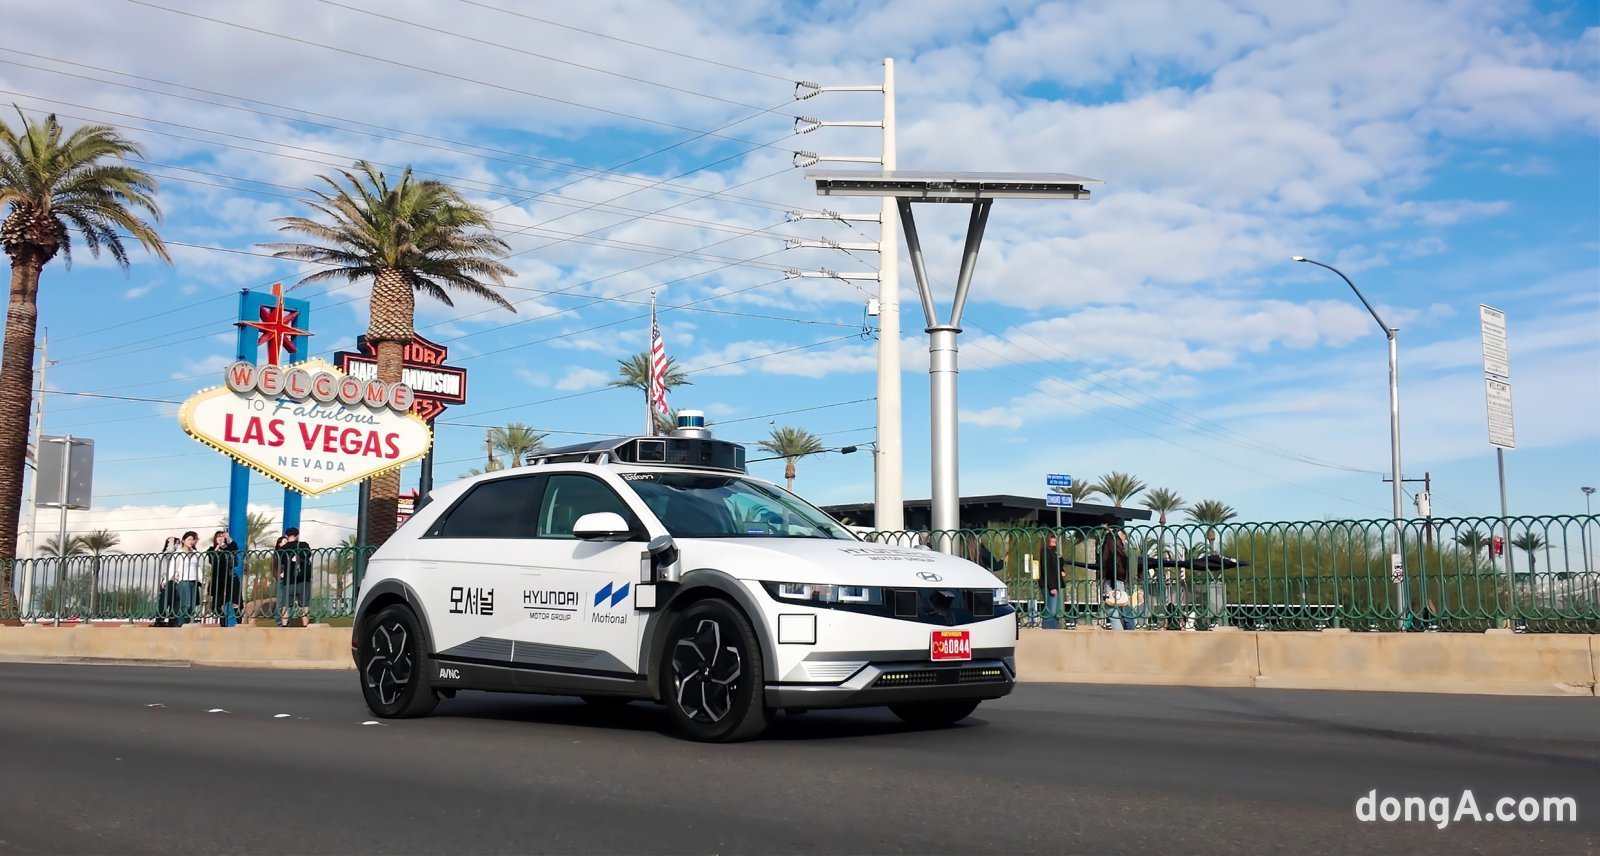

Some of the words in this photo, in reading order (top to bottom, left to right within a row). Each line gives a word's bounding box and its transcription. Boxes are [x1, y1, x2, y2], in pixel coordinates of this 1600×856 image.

[233, 366, 406, 405] WELCOME
[246, 398, 265, 412] TO
[272, 397, 380, 425] Fabulous
[224, 413, 285, 447] LAS
[298, 421, 401, 460] VEGAS
[278, 455, 346, 473] NEVADA
[449, 586, 494, 616] 모셔널
[523, 590, 578, 607] HYUNDAI
[529, 611, 550, 621] MOTOR
[550, 612, 572, 622] GROUP
[591, 612, 627, 625] Motional
